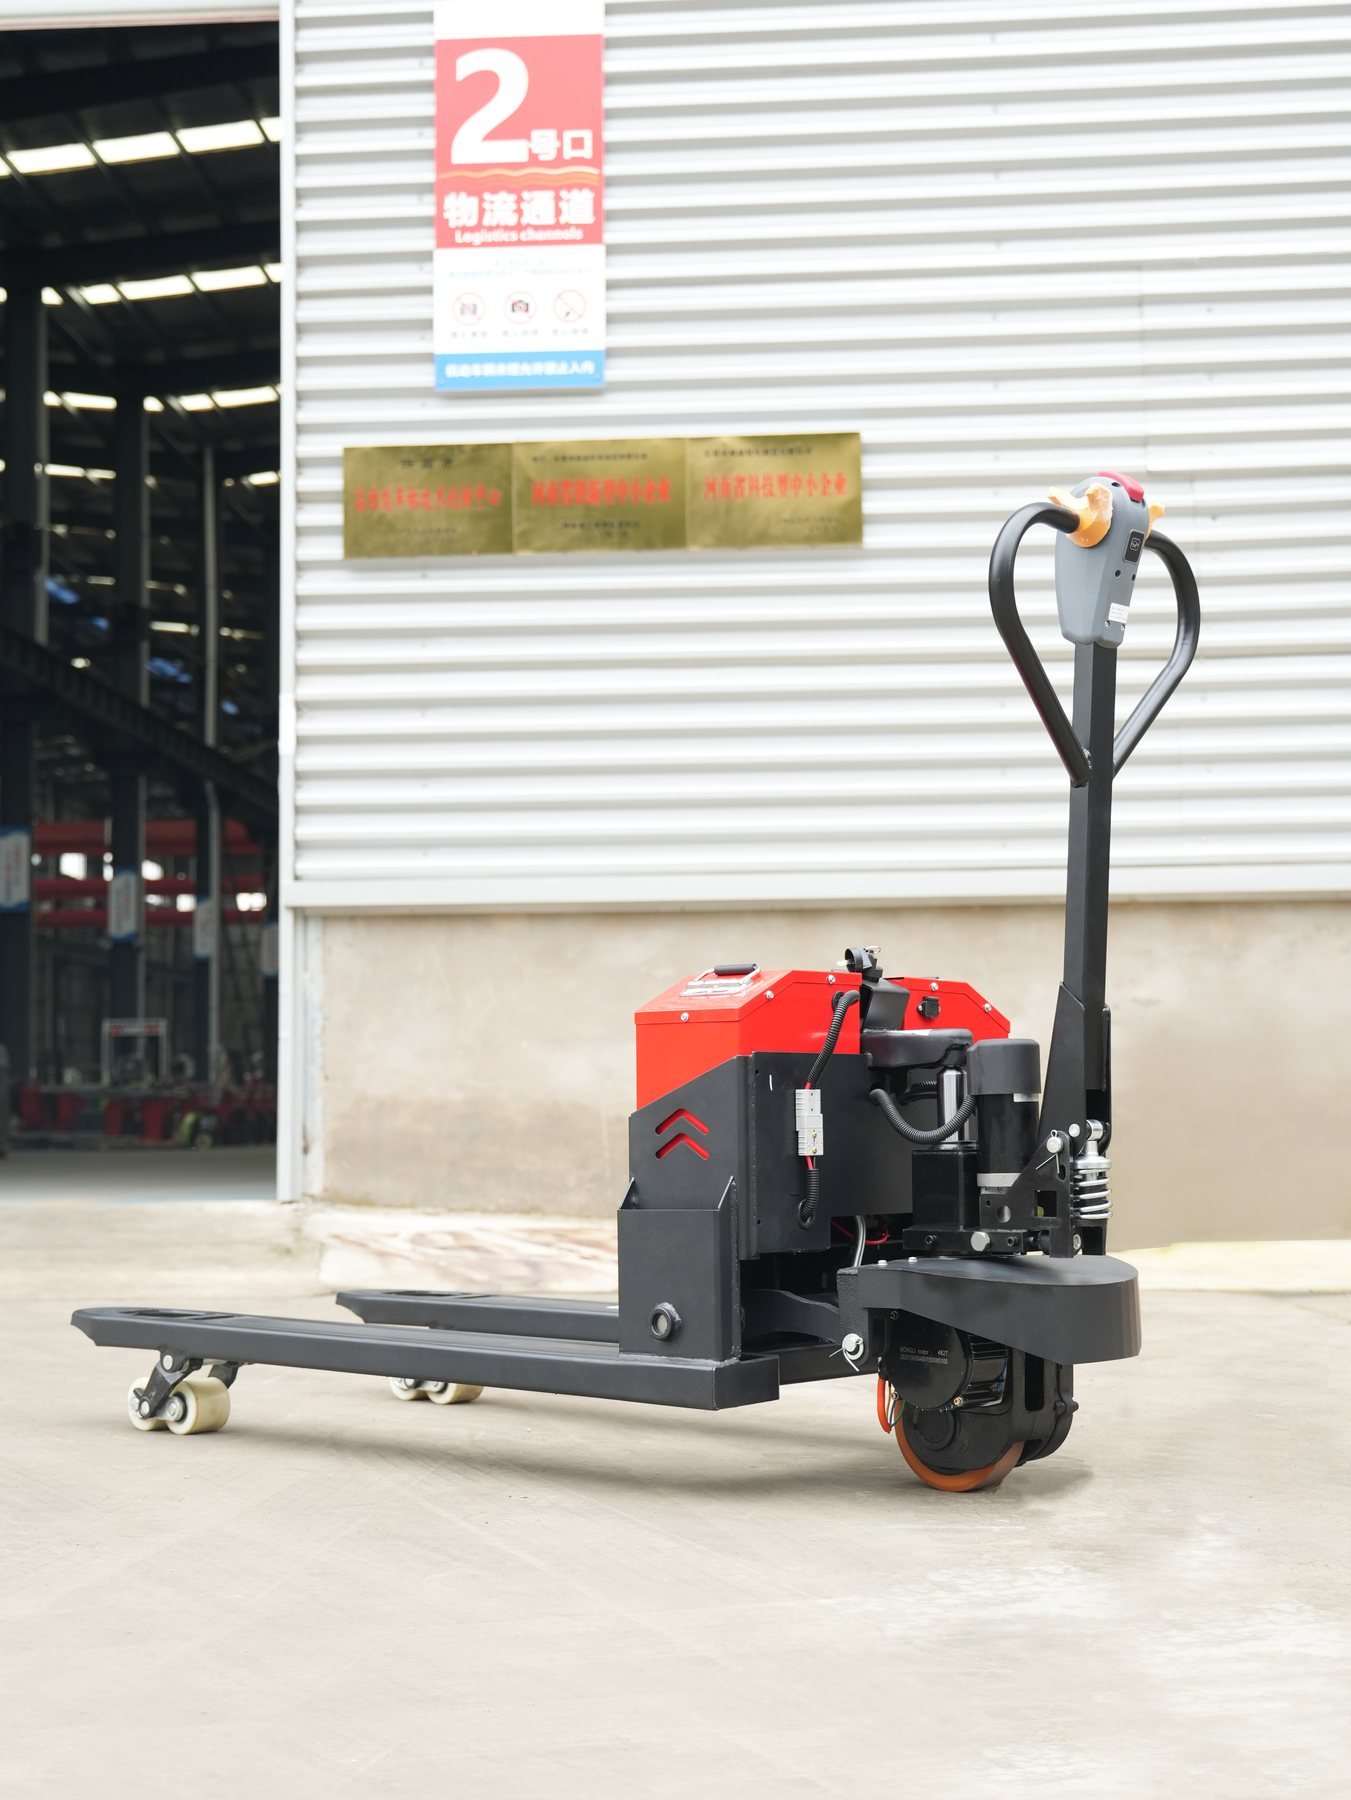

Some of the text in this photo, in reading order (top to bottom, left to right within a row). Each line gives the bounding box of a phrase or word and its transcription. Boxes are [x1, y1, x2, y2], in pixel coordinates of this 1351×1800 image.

[443, 188, 596, 227] 物流通道
[454, 228, 583, 246] Logistics channels
